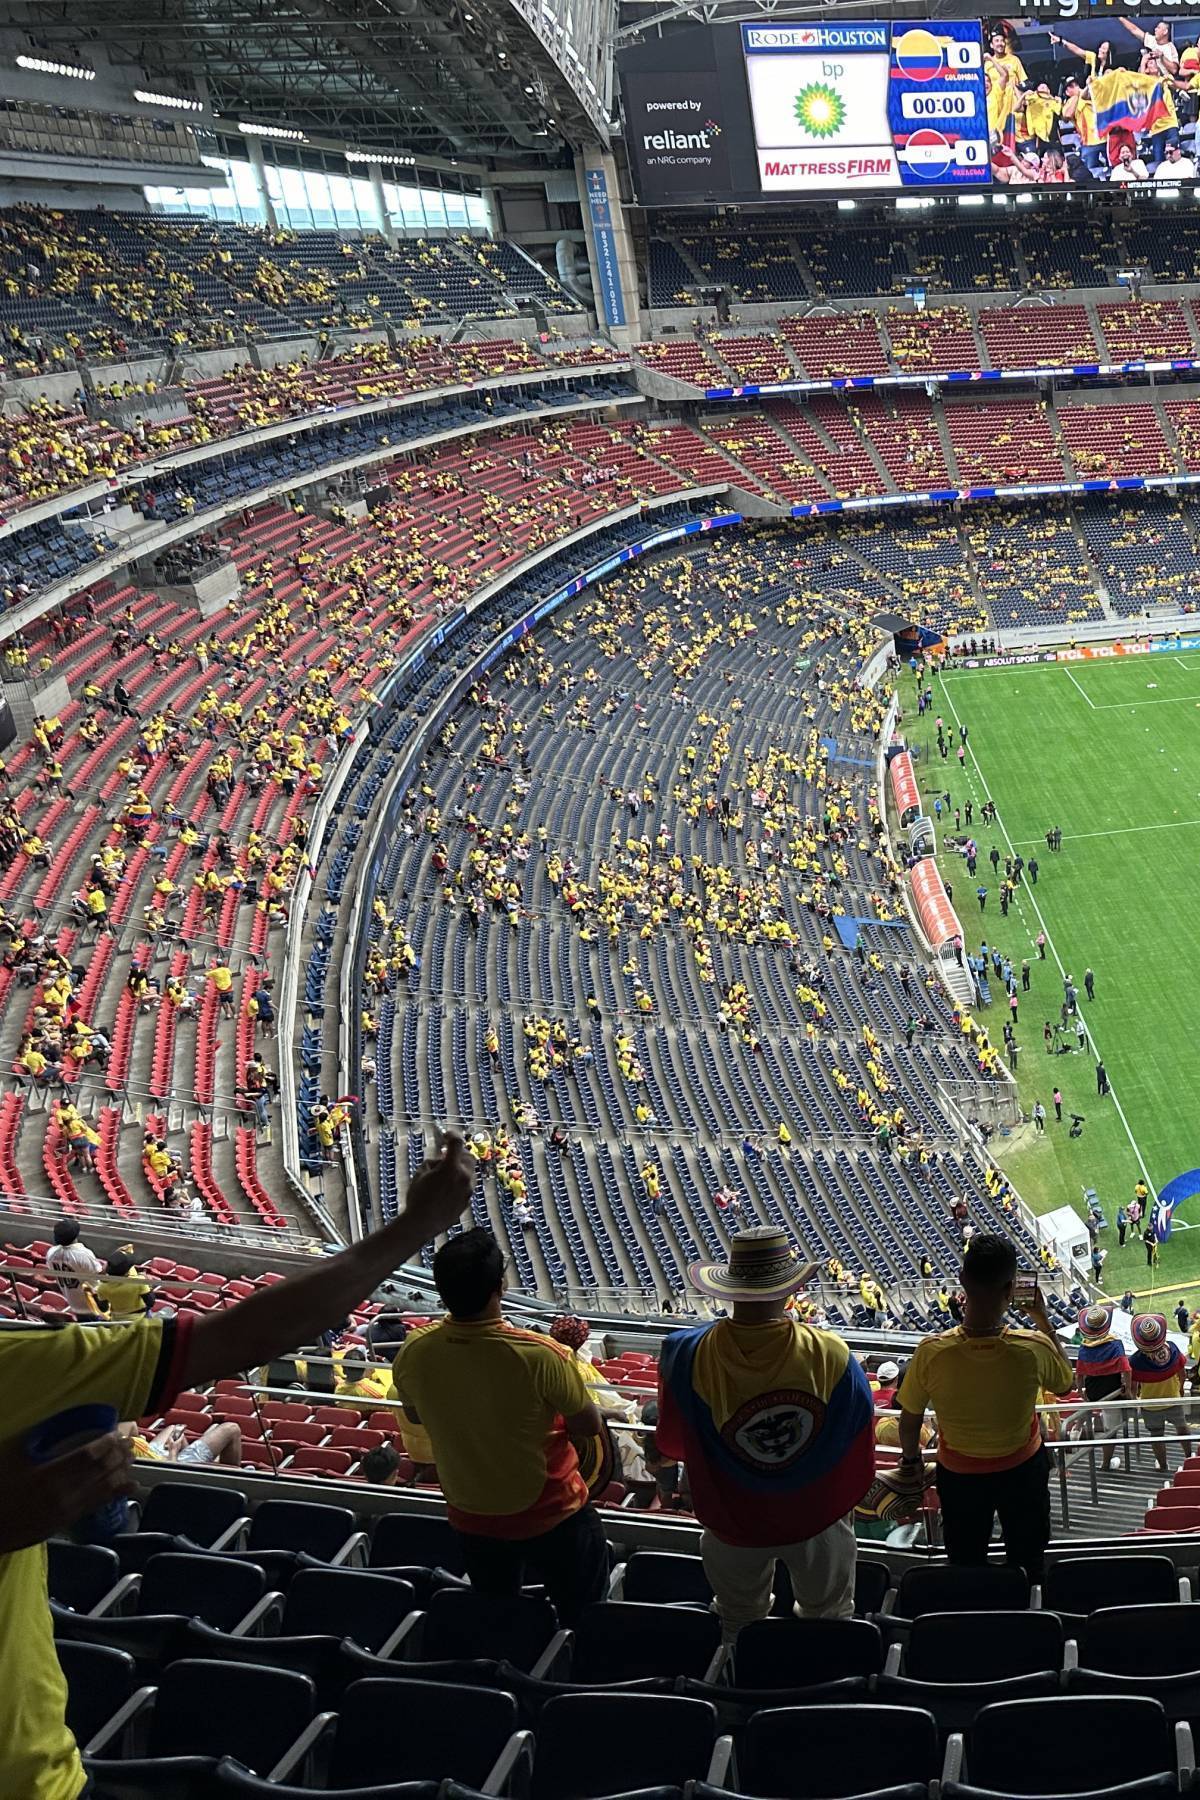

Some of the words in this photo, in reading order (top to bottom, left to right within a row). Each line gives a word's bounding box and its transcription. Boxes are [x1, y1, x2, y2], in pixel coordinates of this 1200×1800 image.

[818, 28, 887, 46] HOUSTON
[959, 47, 970, 64] 0
[822, 61, 844, 80] bp
[944, 73, 979, 81] COLOMBIA
[646, 100, 689, 112] powered
[690, 100, 702, 112] by
[912, 97, 965, 114] 00:00
[643, 130, 711, 150] reliant
[966, 146, 976, 161] 0
[646, 157, 658, 165] an
[657, 156, 676, 164] NRG
[676, 156, 712, 165] company
[1058, 649, 1085, 660] TCL
[1090, 646, 1118, 657] TCL
[1124, 643, 1149, 654] TCL
[983, 656, 1017, 667] ABSOLUT
[1017, 654, 1040, 664] SPORT
